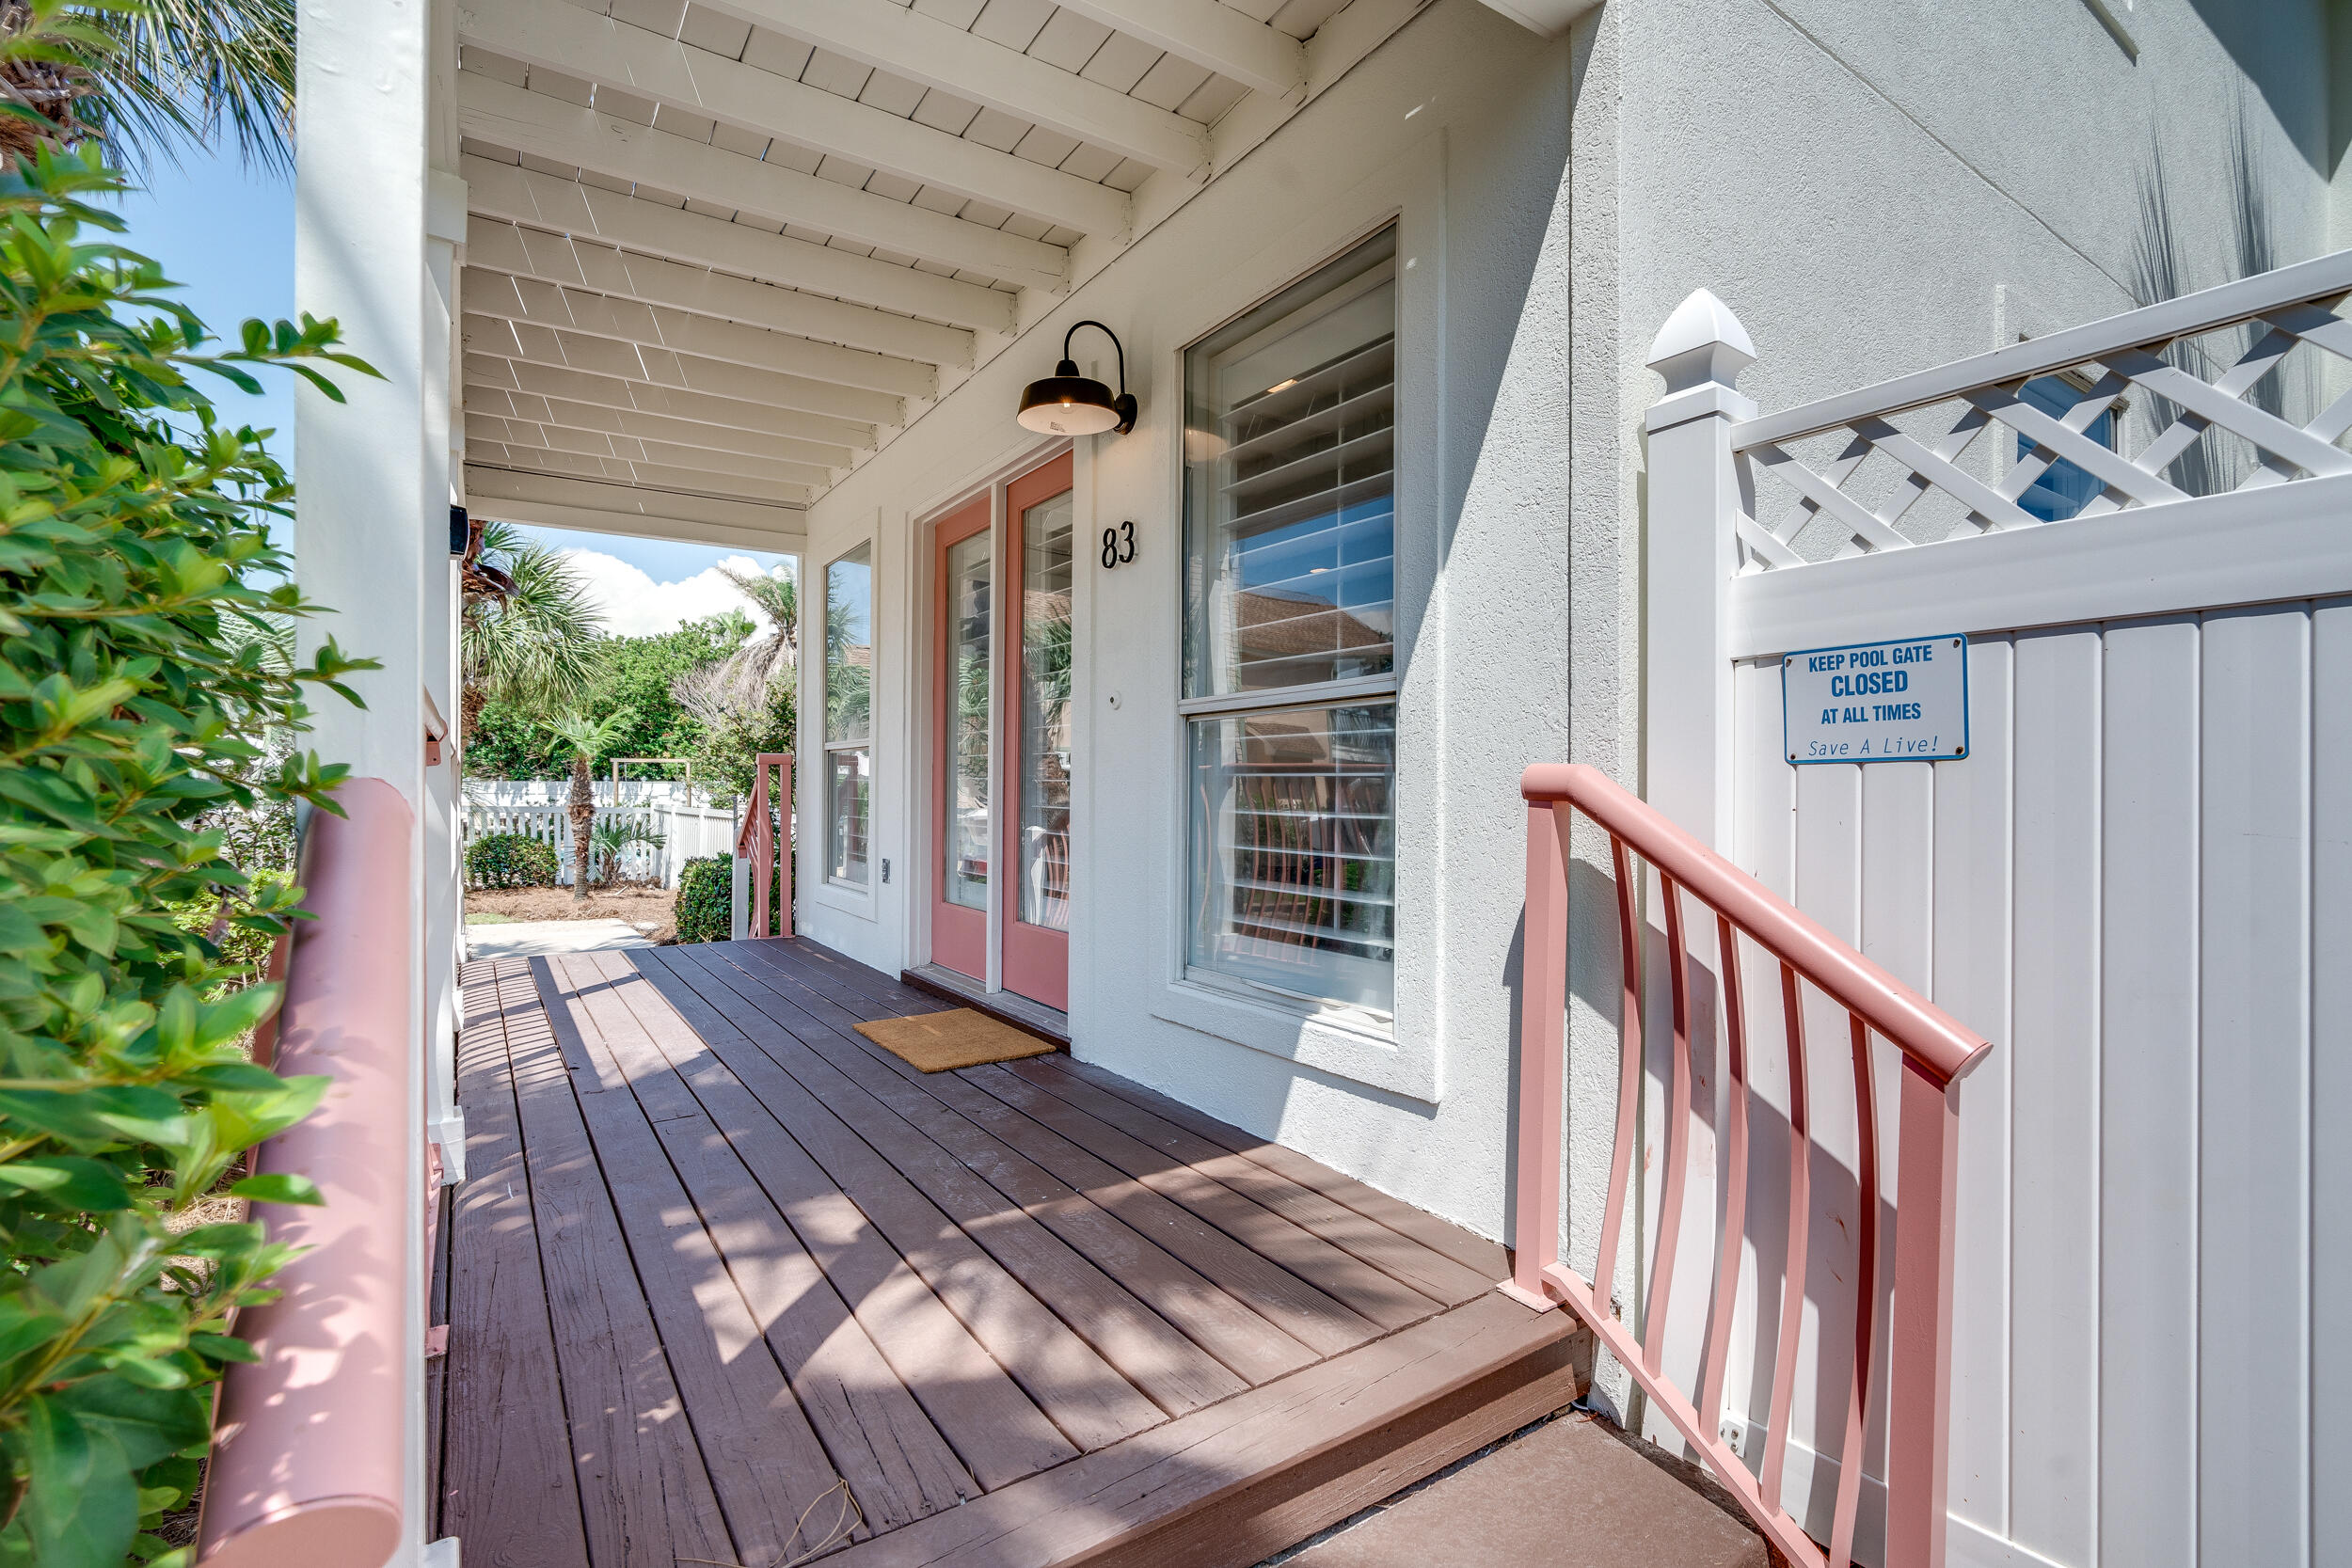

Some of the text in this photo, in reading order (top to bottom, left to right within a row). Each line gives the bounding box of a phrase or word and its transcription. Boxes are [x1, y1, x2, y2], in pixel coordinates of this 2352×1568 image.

[1102, 521, 1135, 568] 83
[1808, 644, 1932, 673] KEEP POOL GATE
[1831, 670, 1908, 697] CLOSED
[1820, 703, 1921, 724] AT ALL TIMES
[1808, 736, 1938, 756] Save A Live!
